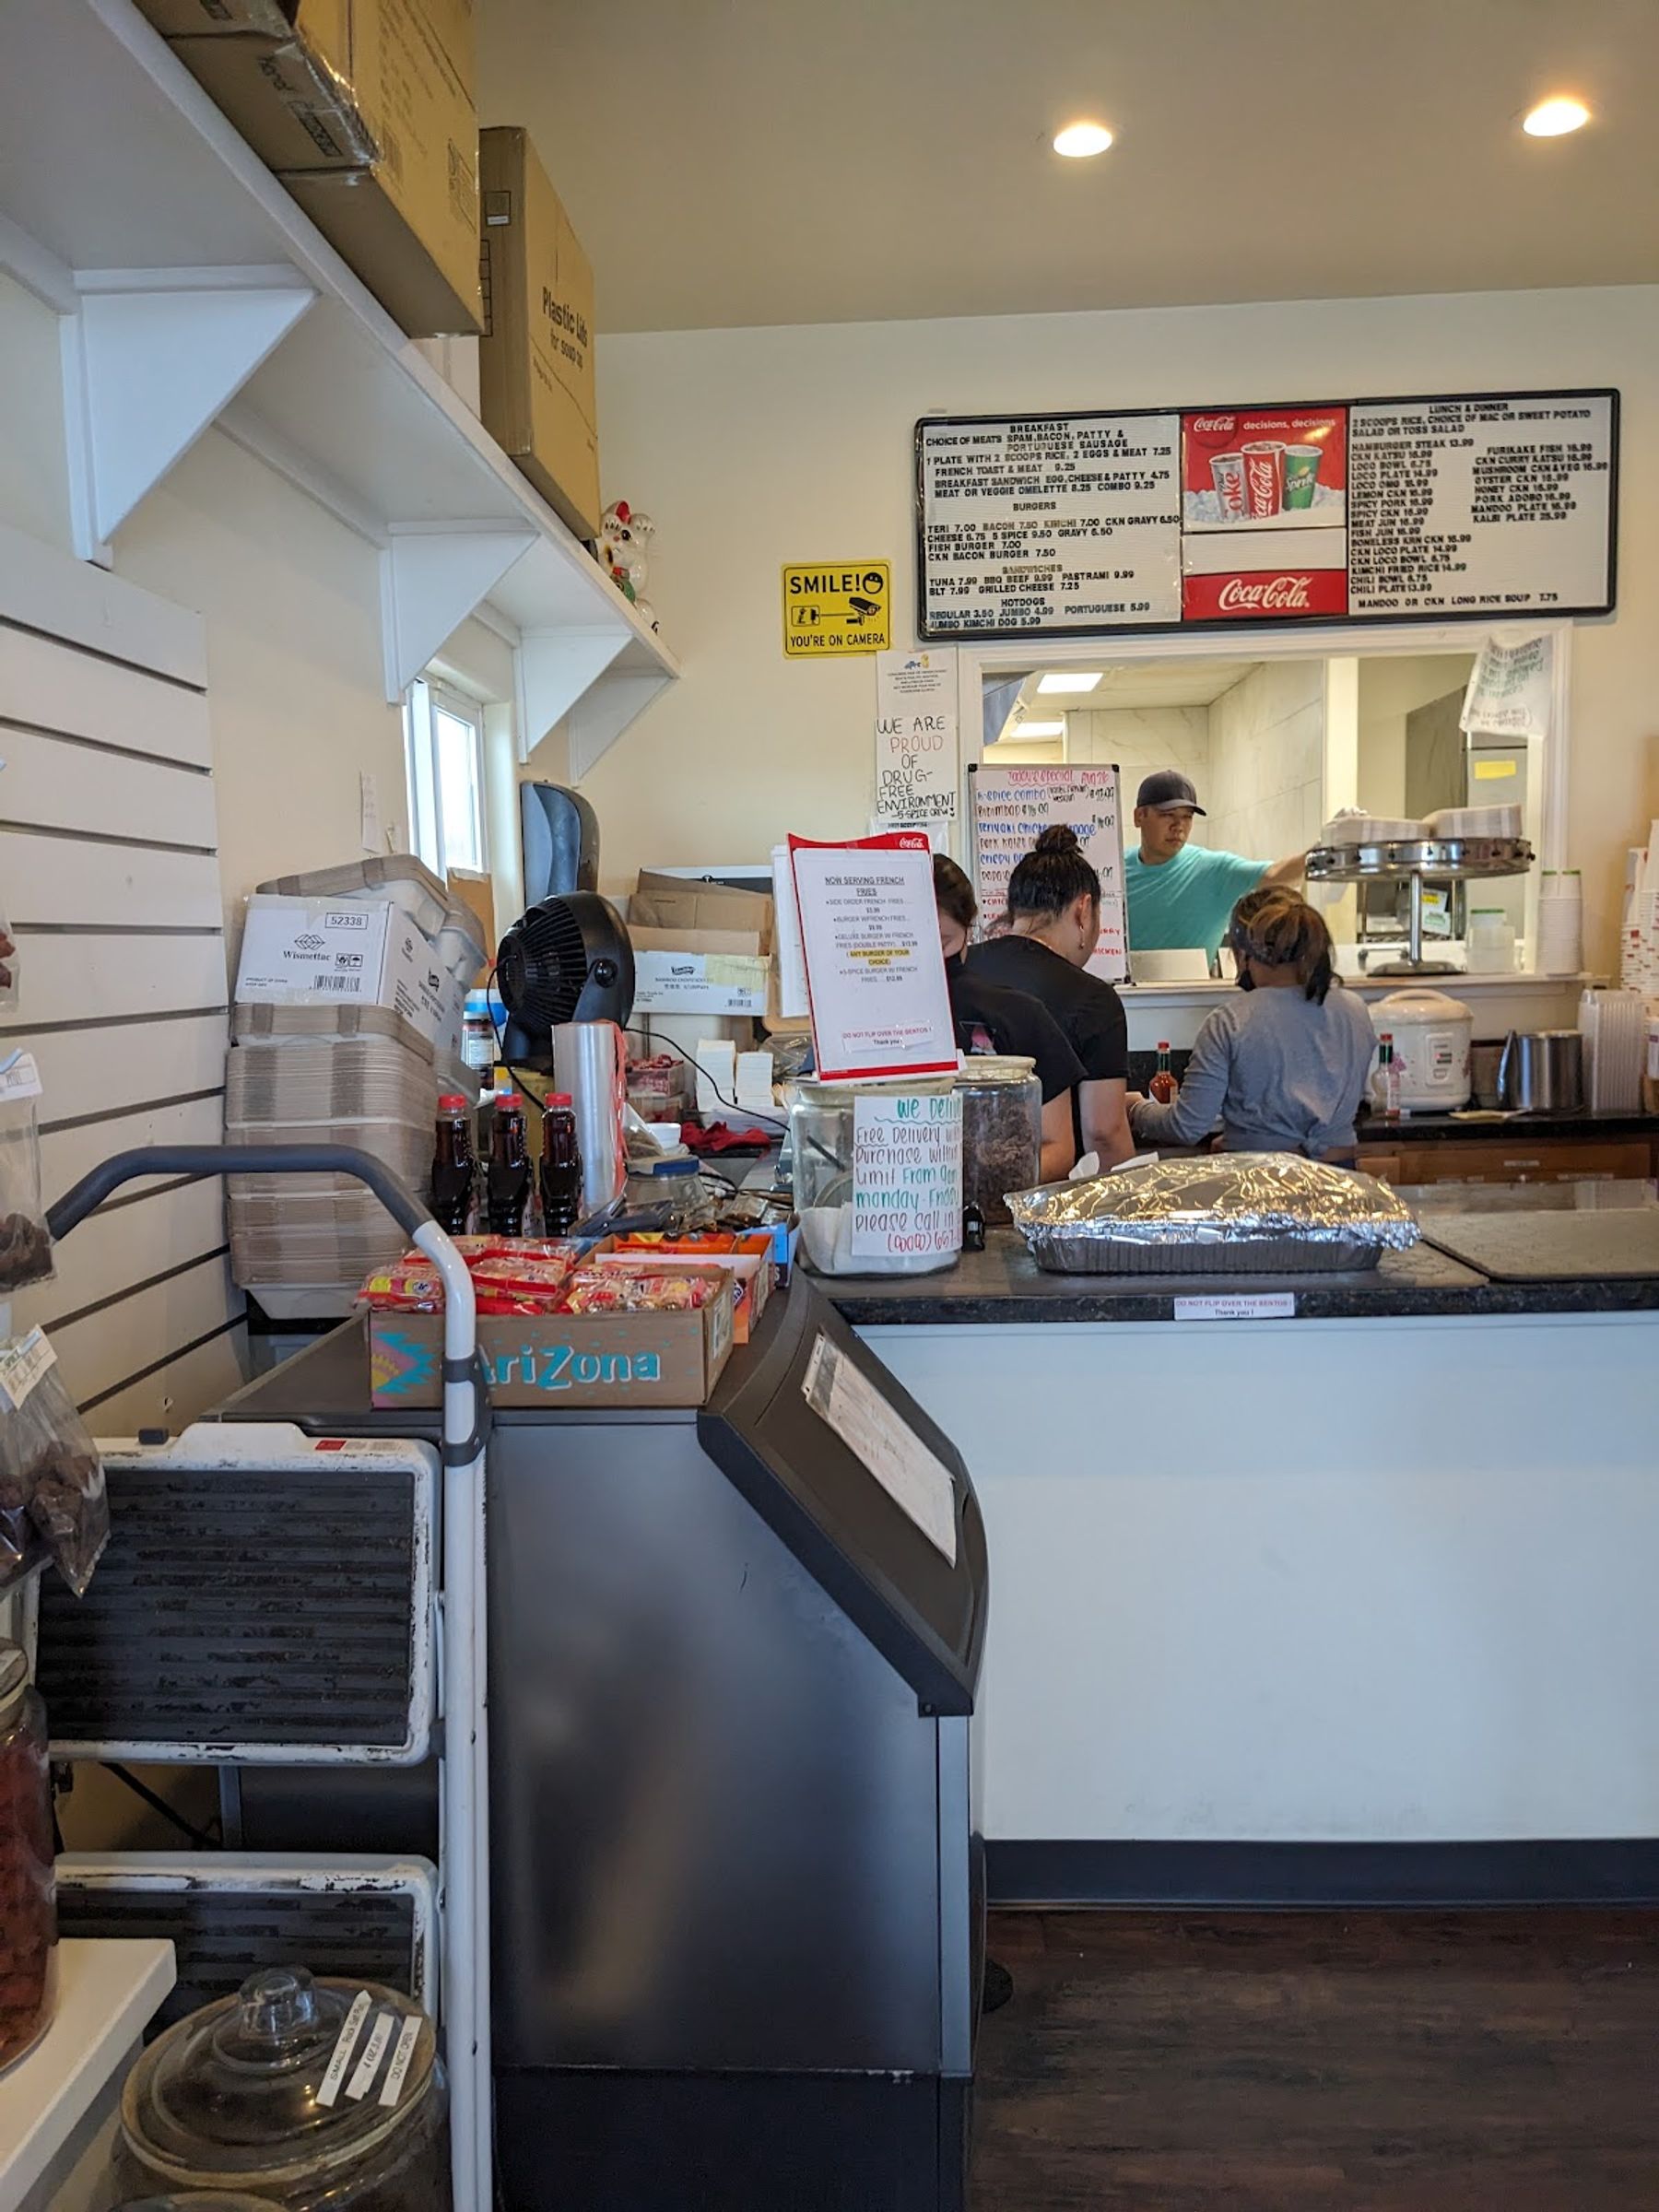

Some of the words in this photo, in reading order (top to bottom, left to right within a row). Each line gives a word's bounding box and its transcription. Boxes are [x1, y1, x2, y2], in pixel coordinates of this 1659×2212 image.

[543, 286, 575, 335] Plastic
[1430, 406, 1461, 414] LUNCH
[1474, 403, 1508, 411] DINNER
[1428, 415, 1462, 424] CHOICE
[1465, 414, 1476, 422] OF
[1479, 413, 1499, 421] MAC
[1502, 412, 1515, 420] OR
[1518, 411, 1550, 420] SWEET
[1554, 410, 1591, 418] POTATO
[1010, 423, 1068, 433] BREAKFAST
[1194, 417, 1235, 431] Coca-Cola
[1243, 420, 1289, 430] decisions,
[1292, 418, 1335, 428] decisions
[1352, 428, 1384, 437] SALAD
[1404, 426, 1428, 434] TOSS
[1431, 424, 1465, 433] SALAD
[926, 437, 958, 446] CHOICE
[972, 435, 1002, 443] MEATS
[1077, 430, 1111, 439] PATTY
[1080, 439, 1127, 449] SAUSAGE
[1352, 441, 1412, 452] HAMBURGER
[1415, 440, 1445, 449] STEAK
[934, 456, 962, 465] PLATE
[967, 454, 991, 463] WITH
[1005, 453, 1041, 461] SCOOPS
[1083, 450, 1109, 458] EGGS
[1122, 448, 1147, 456] MEAT
[1153, 447, 1171, 455] 7.25
[935, 467, 972, 477] FRENCH
[977, 465, 1004, 475] TOAST
[1018, 465, 1042, 473] MEAT
[1055, 463, 1076, 471] 9.25
[1352, 462, 1376, 471] LOCO
[1380, 461, 1406, 470] BOWL
[935, 478, 988, 488] BREAKFAST
[991, 477, 1040, 486] SANDWICH
[1113, 472, 1146, 480] PATTY
[1151, 471, 1170, 479] 4.75
[1351, 472, 1376, 480] LOCO
[1381, 470, 1410, 479] PLATE
[935, 489, 959, 498] MEAT
[964, 488, 978, 497] OR
[982, 487, 1015, 496] VEGGIE
[1018, 485, 1067, 494] OMELETTE
[1098, 482, 1131, 490] COMBO
[1249, 457, 1273, 521] ca-Cola
[1509, 493, 1542, 501] ADOBO
[1013, 502, 1056, 511] BURGERS
[1518, 503, 1547, 512] PLATE
[1506, 513, 1535, 522] PLATE
[928, 524, 949, 534] TERI
[955, 524, 976, 532] 7.00
[982, 522, 1015, 531] BACON
[1080, 518, 1100, 526] 7.00
[1105, 517, 1125, 525] CKN
[1127, 516, 1158, 524] GRAVY
[928, 534, 963, 543] CHEESE
[1001, 531, 1029, 539] SPICE
[1058, 528, 1088, 537] GRAVY
[929, 544, 950, 552] FISH
[955, 542, 994, 551] BURGER
[1003, 541, 1021, 549] 7.00
[1351, 548, 1371, 557] CKN
[1373, 547, 1397, 556] LOCO
[1400, 546, 1429, 554] PLATE
[928, 553, 948, 561] CKN
[953, 552, 984, 560] BACON
[990, 550, 1029, 559] BURGER
[1036, 548, 1056, 557] 7.50
[1003, 564, 1063, 574] SANDWICHES
[1388, 565, 1414, 573] FRIED
[1418, 564, 1440, 572] RICE
[790, 573, 860, 594] SMILE!
[930, 578, 955, 586] TUNA
[959, 577, 978, 585] 7.99
[1006, 574, 1030, 583] BEEF
[1062, 571, 1110, 581] PASTRAMI
[929, 588, 946, 596] BLT
[950, 586, 970, 594] 7.99
[979, 584, 1016, 594] GRILLED
[1019, 582, 1054, 592] CHEESE
[1061, 582, 1080, 590] 7.25
[1218, 577, 1312, 610] Coca-Cola
[1001, 597, 1045, 606] HOTDOGS
[1359, 598, 1398, 607] MANDOO
[1405, 598, 1418, 606] OR
[1424, 597, 1444, 606] CKN
[1452, 596, 1476, 606] LONG
[1479, 594, 1500, 604] RICE
[1505, 594, 1530, 603] SOUP
[930, 610, 971, 620] REGULAR
[999, 607, 1030, 617] JUMBO
[1065, 604, 1125, 614] PORTUGUESE
[930, 619, 960, 629] JUMBO
[964, 618, 995, 628] KIMCHI
[998, 618, 1018, 626] DOG
[791, 634, 825, 647] YOU'RE
[829, 635, 843, 646] ON
[846, 633, 885, 645] CAMERA
[877, 717, 903, 735] WE
[913, 715, 946, 732] ARE
[889, 735, 944, 753] PROUD
[901, 754, 919, 770] OF
[878, 783, 915, 800] FREE
[825, 877, 841, 886] NOW
[843, 877, 875, 886] SERVING
[876, 876, 905, 885] FRENCH
[856, 888, 877, 897] FRIES
[331, 916, 363, 926] 52338
[283, 950, 332, 961] Wismettac
[330, 2049, 347, 2081] SMALL
